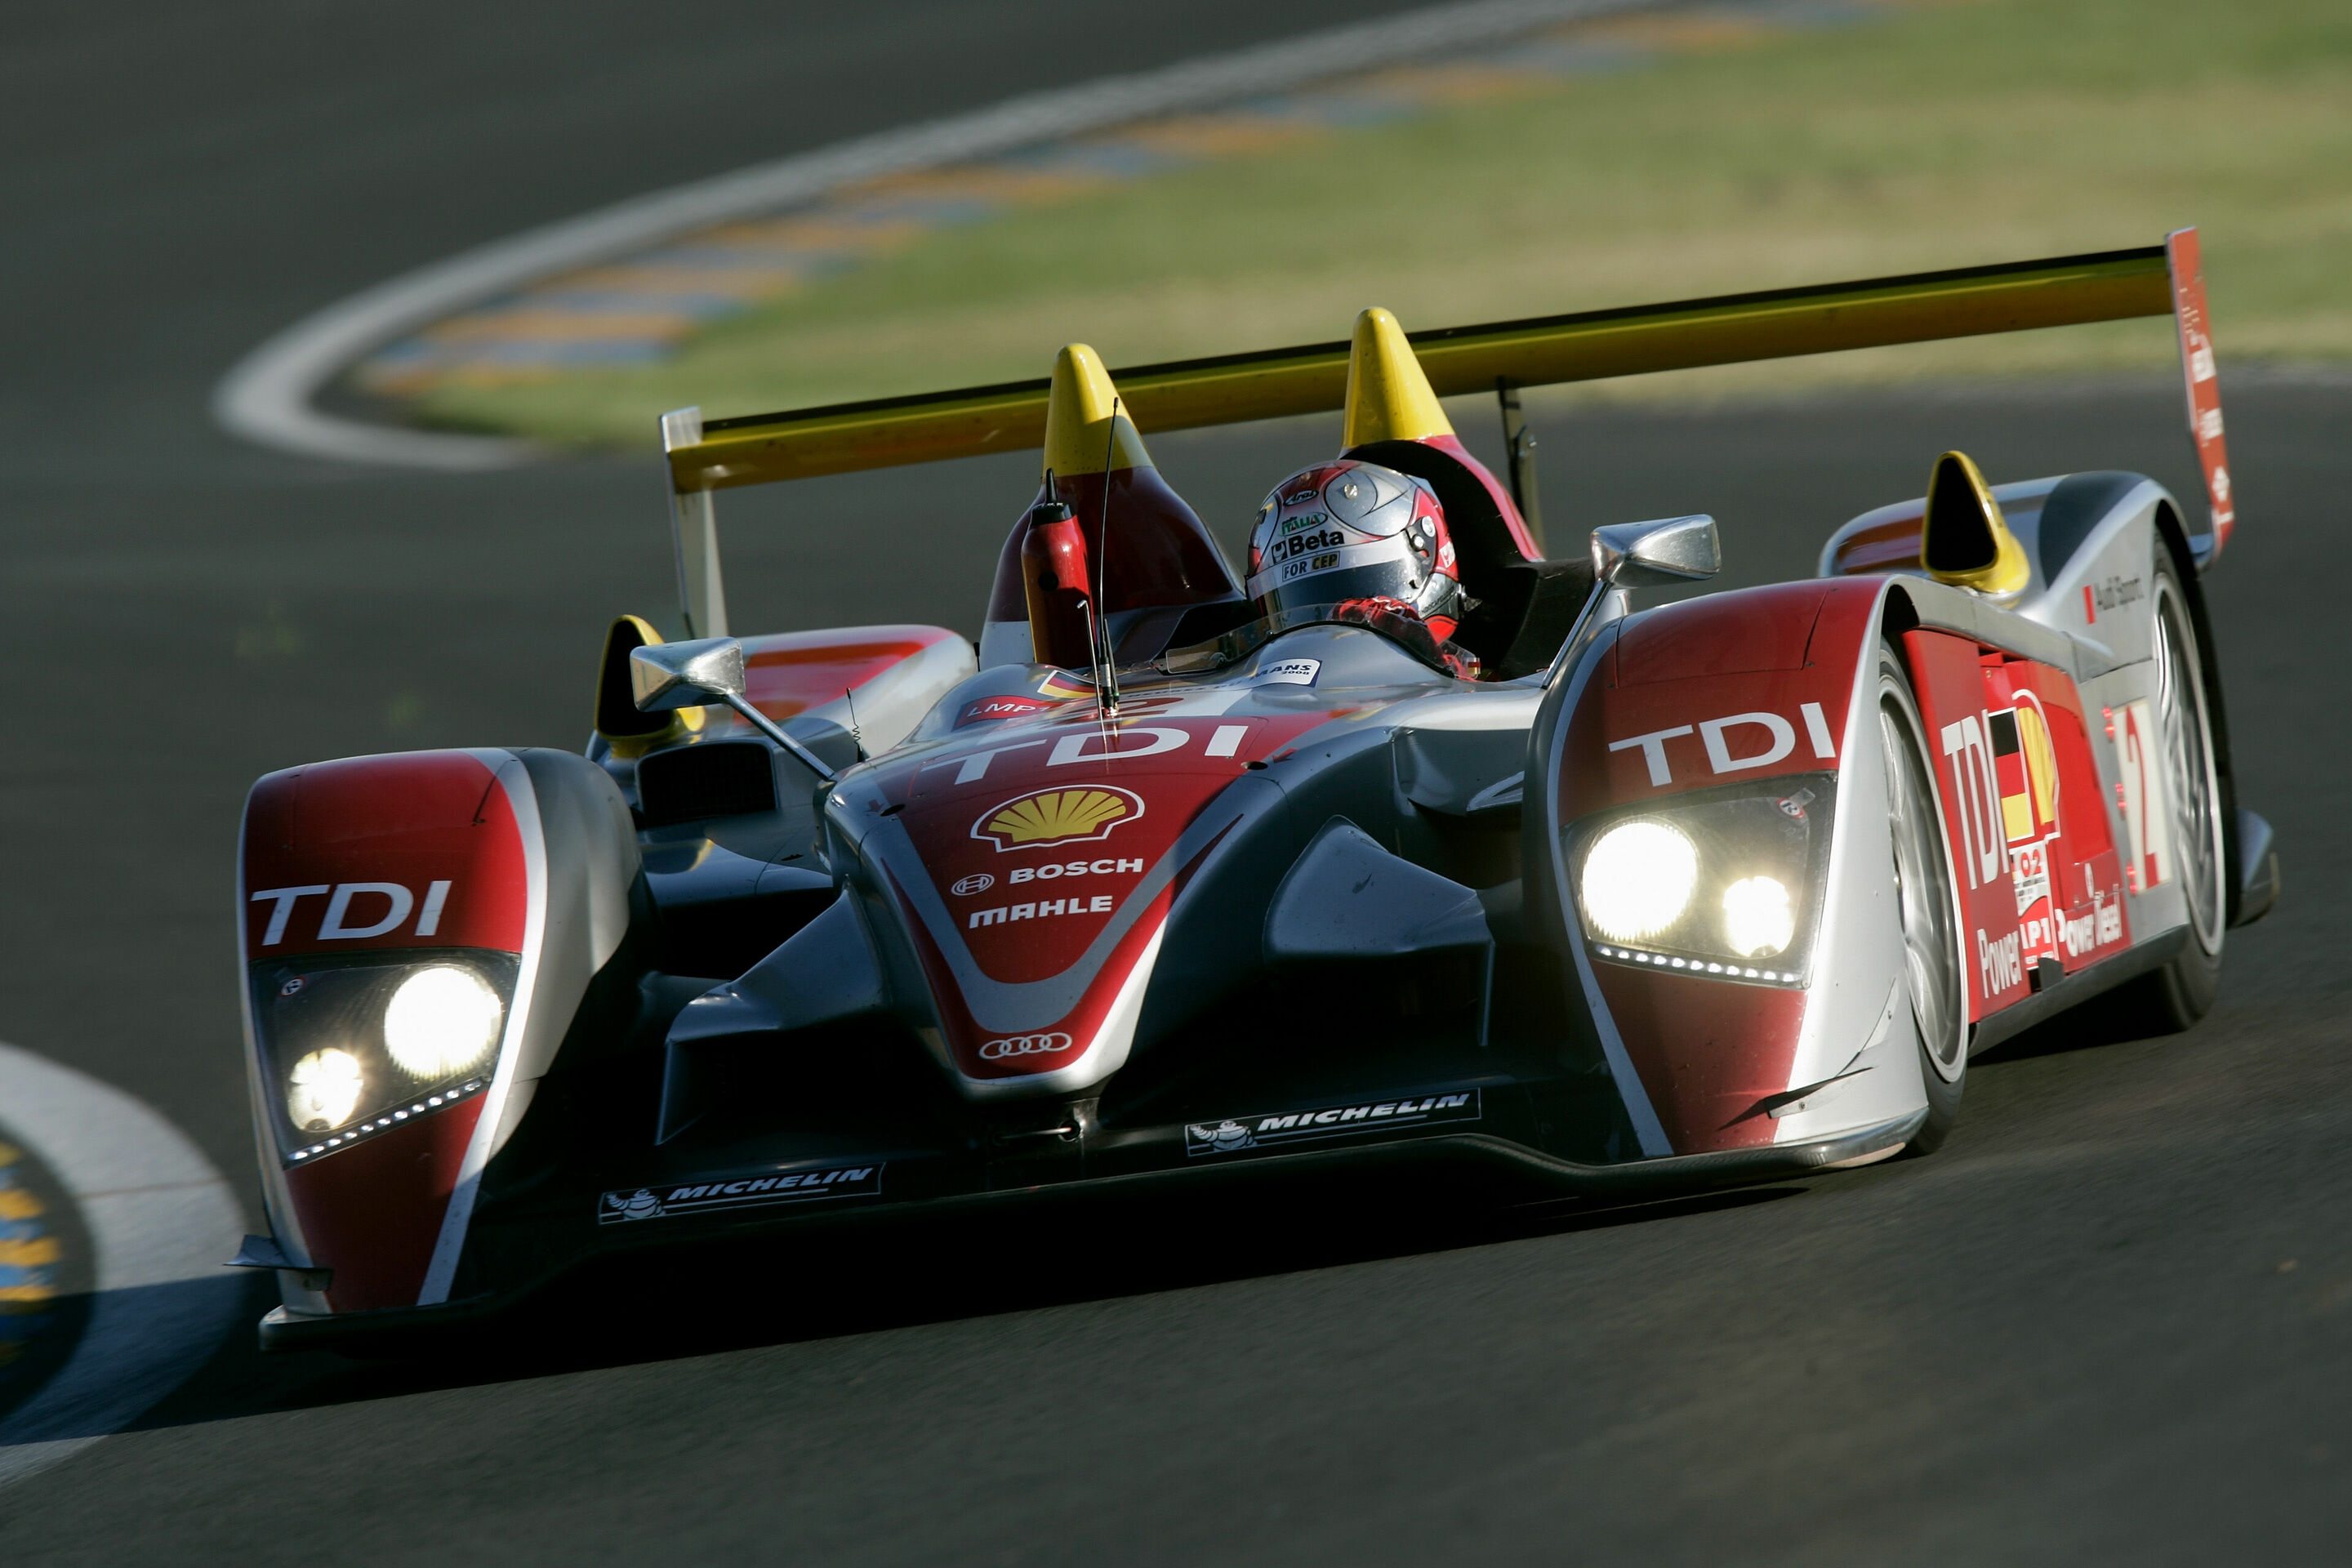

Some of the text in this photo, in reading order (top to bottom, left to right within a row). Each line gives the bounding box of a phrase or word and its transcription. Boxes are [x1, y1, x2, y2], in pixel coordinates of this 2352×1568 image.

[1281, 514, 1321, 536] ITALIA
[1288, 529, 1344, 556] Beta
[1284, 552, 1338, 579] FOR CEP
[967, 702, 1050, 718] LMP1
[921, 725, 1249, 786] TDI
[1608, 702, 1837, 787] TDI
[1940, 709, 2010, 890] TDI
[1009, 858, 1143, 884] BOSCH
[250, 880, 452, 947] TDI
[969, 895, 1113, 929] MAHLE
[1976, 928, 2023, 1000] Power
[1257, 1094, 1470, 1132] MICHELIN
[666, 1167, 874, 1201] MICHELIN
